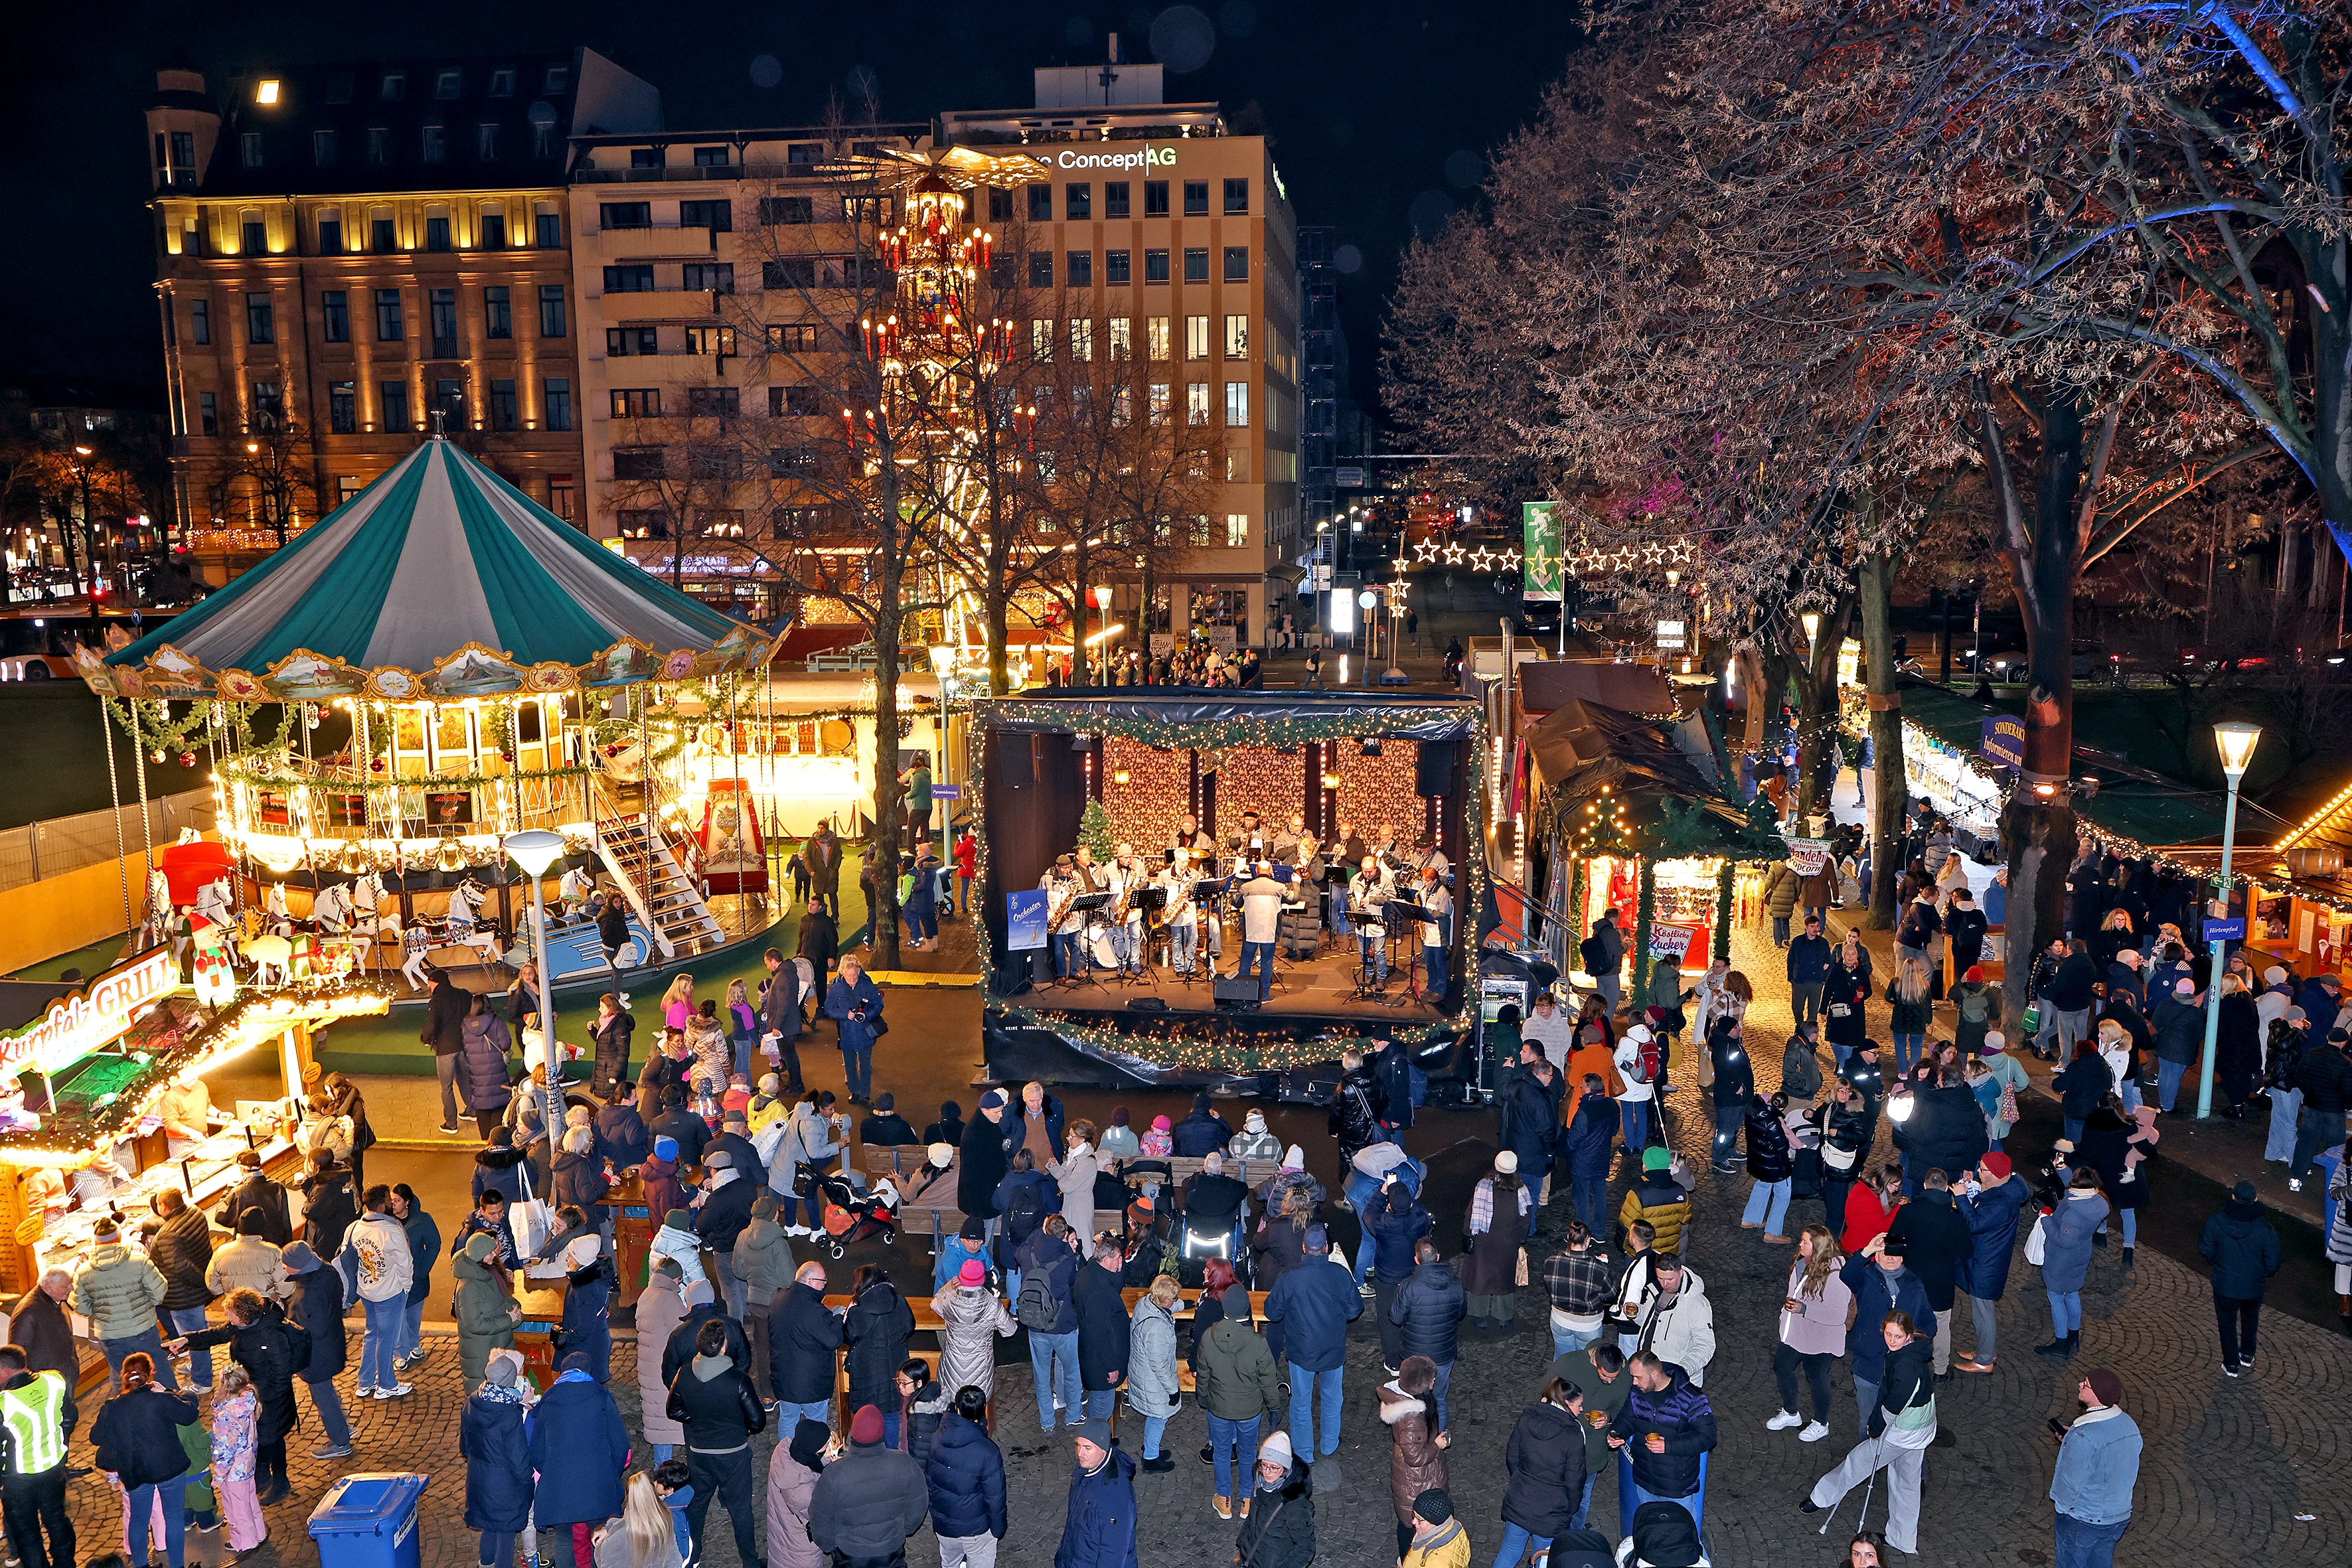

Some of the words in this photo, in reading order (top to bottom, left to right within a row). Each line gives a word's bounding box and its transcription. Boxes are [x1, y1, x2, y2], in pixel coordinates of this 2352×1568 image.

[1058, 149, 1144, 172] Concept
[1147, 147, 1177, 166] AG
[1983, 735, 2014, 763] Informieren
[1013, 901, 1042, 921] Orchester
[1649, 933, 1687, 951] Zucker-
[1654, 924, 1690, 939] Köstliche
[0, 1000, 92, 1070] Kurpfalz
[96, 957, 176, 1018] GRILL
[354, 1238, 385, 1261] STRONGHOLD
